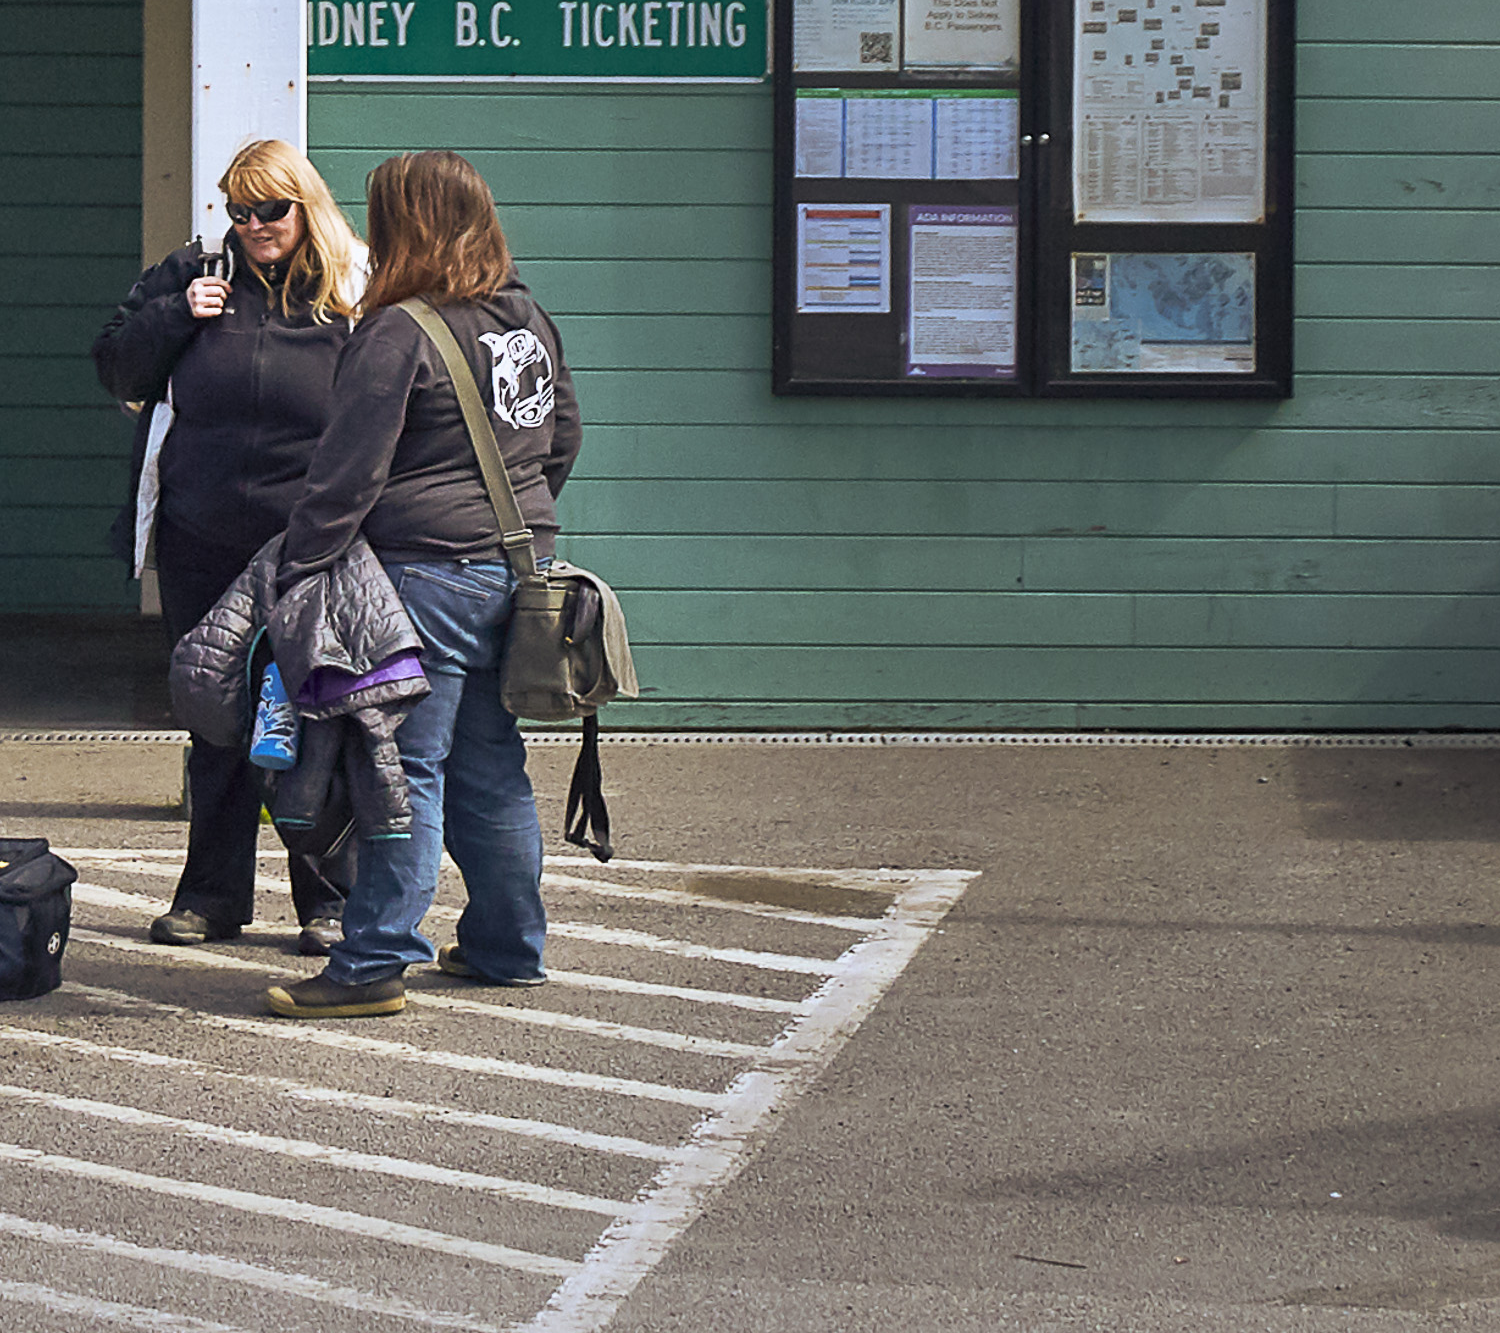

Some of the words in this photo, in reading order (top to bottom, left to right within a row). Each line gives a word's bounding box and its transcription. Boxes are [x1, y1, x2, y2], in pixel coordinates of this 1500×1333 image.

[308, 1, 415, 47] IDNEY
[455, 1, 521, 47] B.C.
[560, 1, 747, 48] TICKETING
